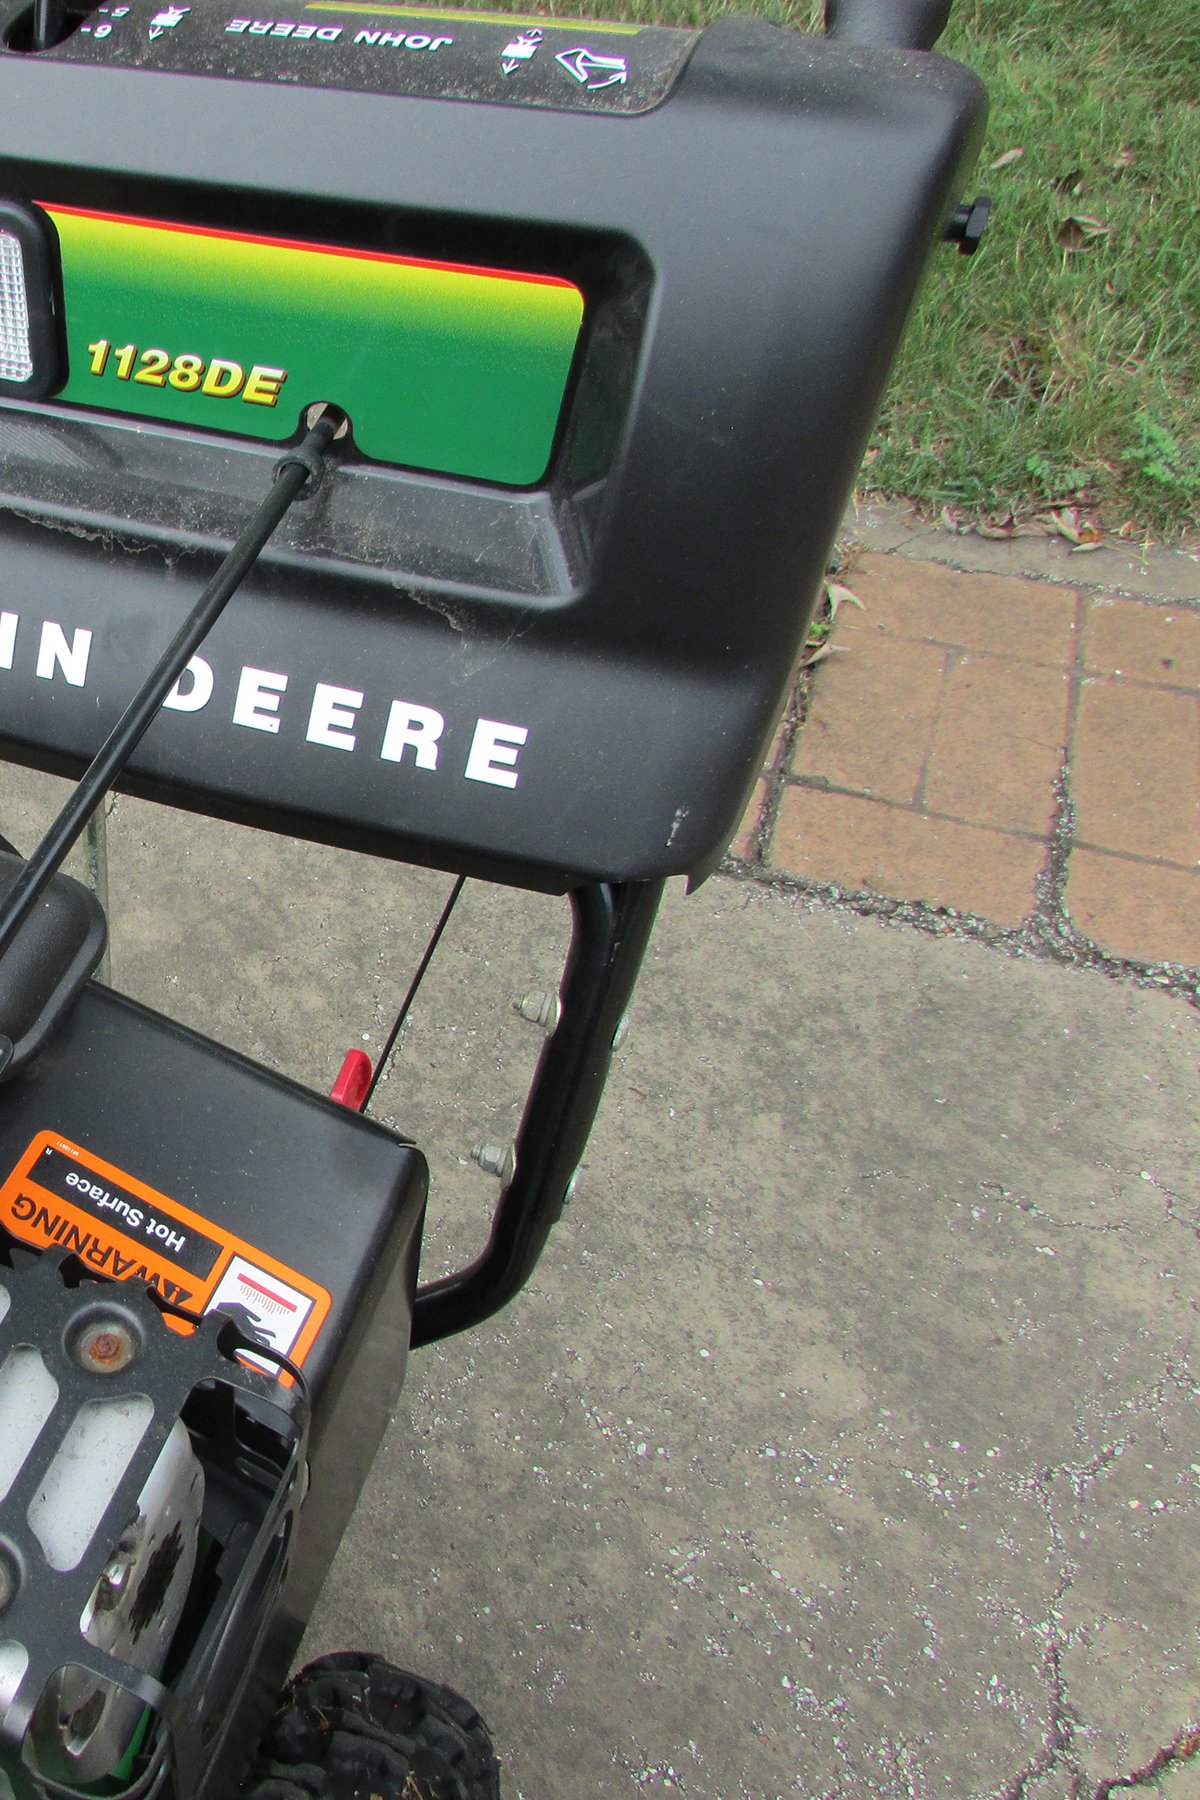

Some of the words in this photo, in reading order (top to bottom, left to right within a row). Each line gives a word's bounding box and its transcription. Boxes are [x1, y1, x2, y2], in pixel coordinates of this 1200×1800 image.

[225, 17, 343, 41] DEERE
[354, 29, 453, 51] JOHN
[87, 338, 288, 407] 1128DE
[162, 655, 529, 789] DEERE
[65, 1172, 143, 1226] Surface
[146, 1218, 185, 1252] Hot
